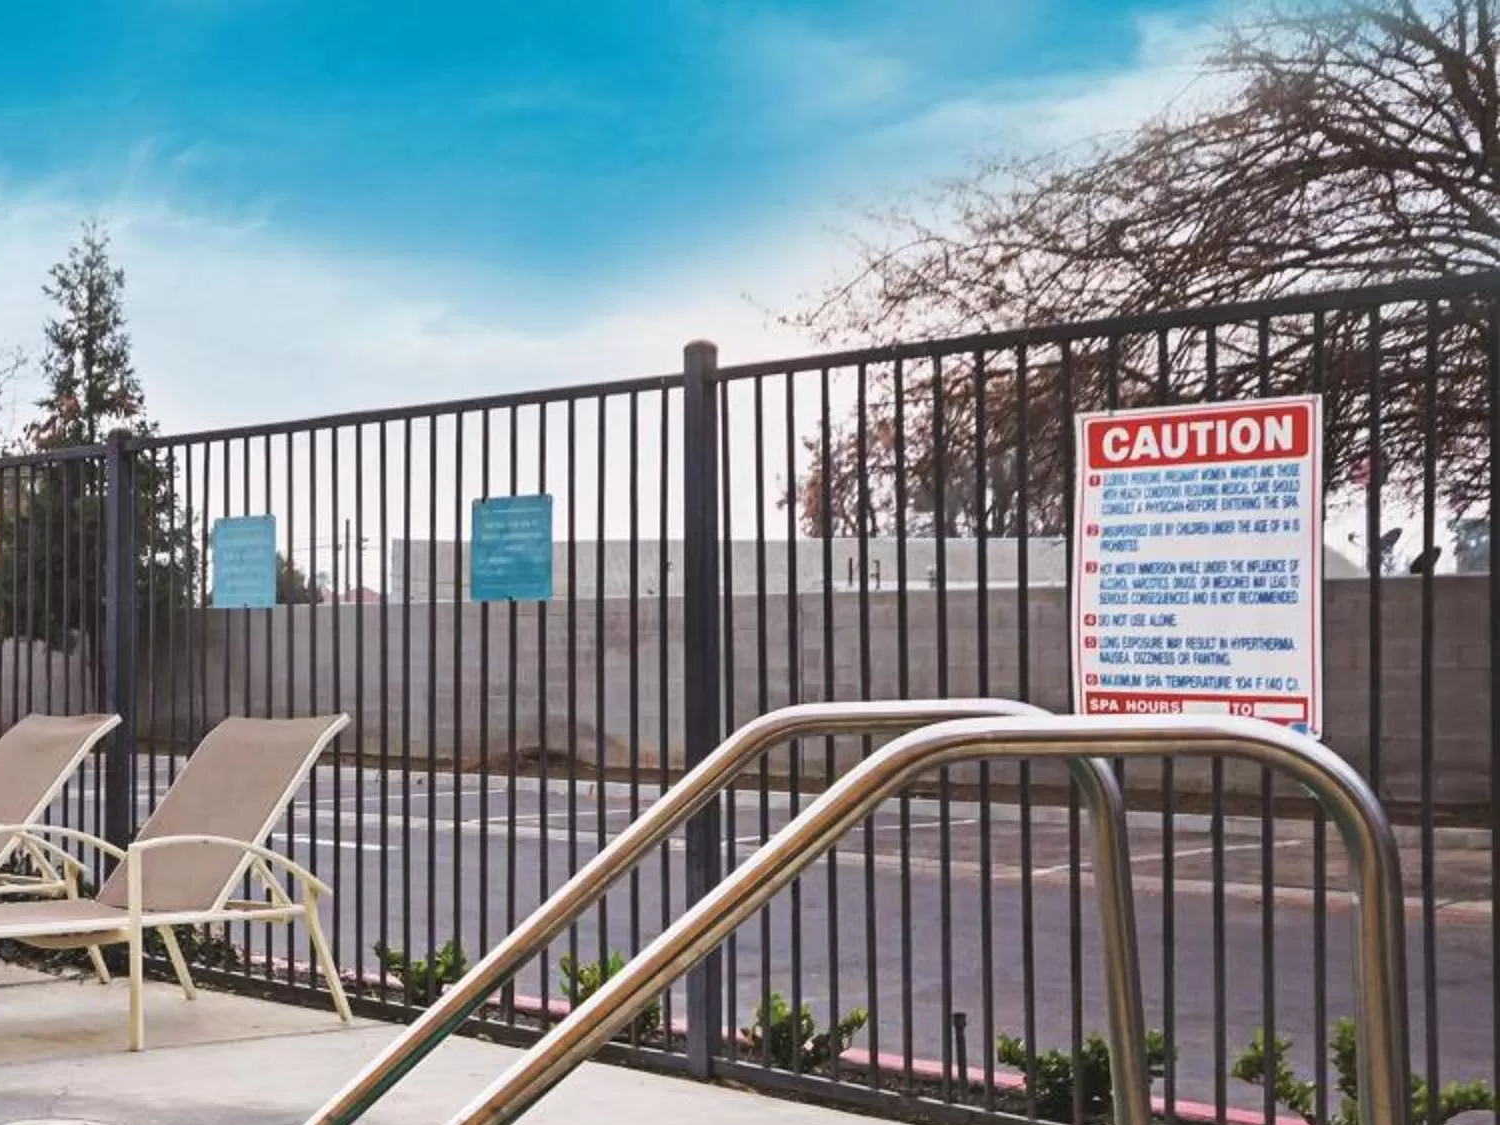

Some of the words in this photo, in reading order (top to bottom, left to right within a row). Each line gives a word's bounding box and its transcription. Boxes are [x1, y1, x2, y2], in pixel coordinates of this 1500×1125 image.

[1102, 414, 1294, 463] CAUTION
[1222, 497, 1260, 510] ENTERING
[1264, 495, 1279, 508] THE
[1230, 560, 1244, 573] THE
[1247, 559, 1286, 573] INFLUENCE
[1289, 559, 1299, 573] OF
[1200, 576, 1210, 589] OR
[1269, 575, 1288, 588] LEAD
[1290, 575, 1300, 588] TO
[1192, 591, 1208, 604] AND
[1220, 591, 1235, 604] NOT
[1099, 613, 1109, 626] DO
[1112, 613, 1127, 626] NOT
[1129, 613, 1145, 626] USE
[1100, 636, 1120, 649] LONG
[1122, 636, 1164, 649] EXPOSURE
[1166, 637, 1182, 649] MAY
[1185, 636, 1216, 650] RESULT
[1219, 637, 1228, 649] IN
[1178, 652, 1190, 665] OR
[1100, 674, 1141, 687] MAXIMUM
[1144, 675, 1162, 688] SPA
[1165, 675, 1231, 689] TEMPERATURE
[1235, 676, 1252, 689] 104
[1089, 698, 1120, 712] SPA
[1125, 699, 1181, 714] HOURS
[1232, 701, 1254, 716] TO
